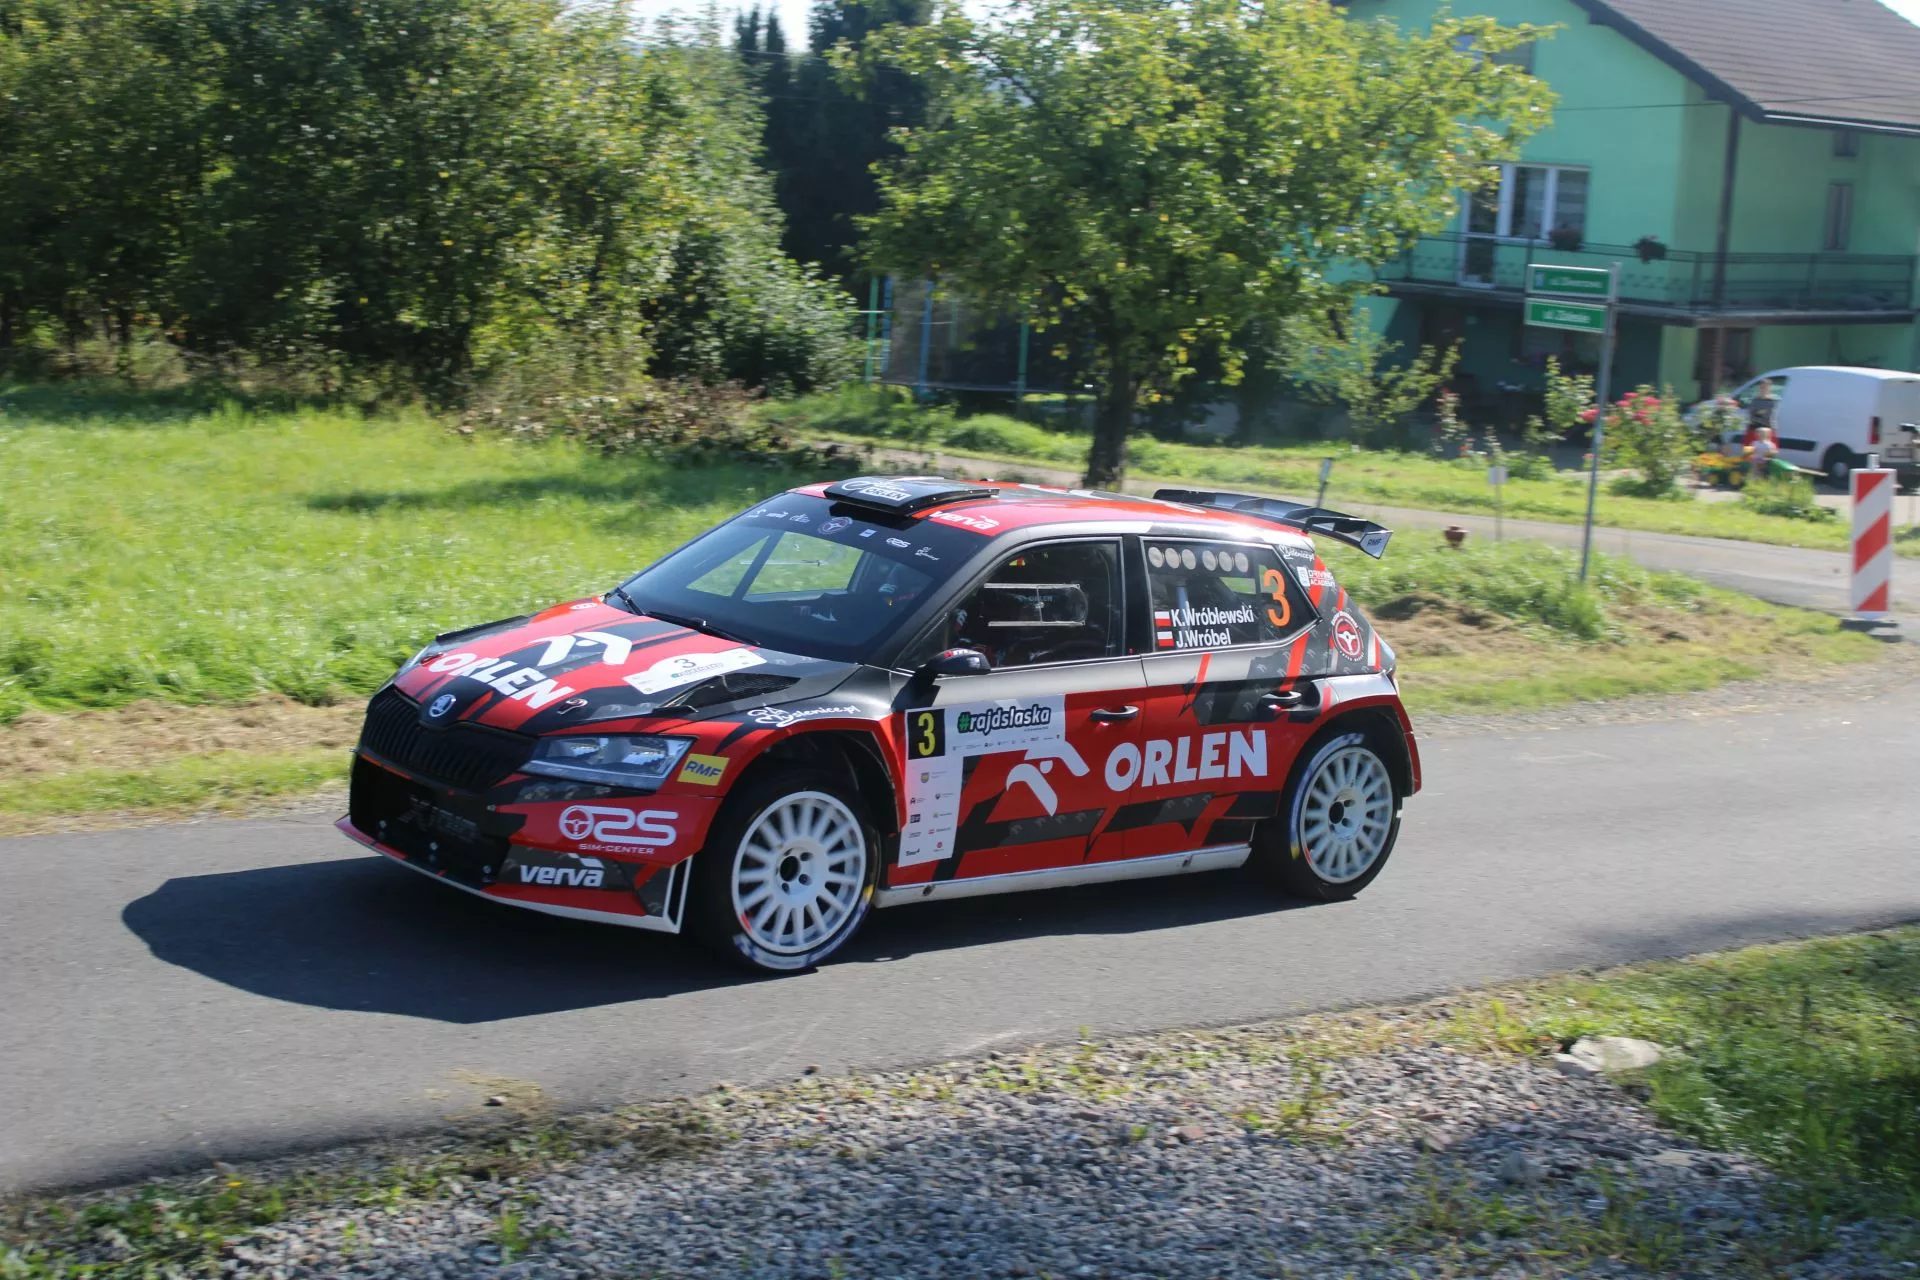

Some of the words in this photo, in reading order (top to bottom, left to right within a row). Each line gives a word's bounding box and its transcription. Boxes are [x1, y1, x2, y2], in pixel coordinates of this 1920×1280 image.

[929, 511, 1000, 530] verva
[1263, 569, 1291, 627] 3
[1171, 605, 1255, 627] K.Wróblewski
[1176, 628, 1232, 648] J.Wróbel
[674, 658, 697, 669] 3
[428, 653, 576, 710] ORLEN
[957, 704, 1051, 735] #rajdslaska
[918, 712, 936, 756] 3
[684, 761, 722, 778] RMF
[1104, 730, 1268, 792] ORLEN
[578, 842, 655, 854] SIM-CENTER
[519, 861, 605, 888] verva
